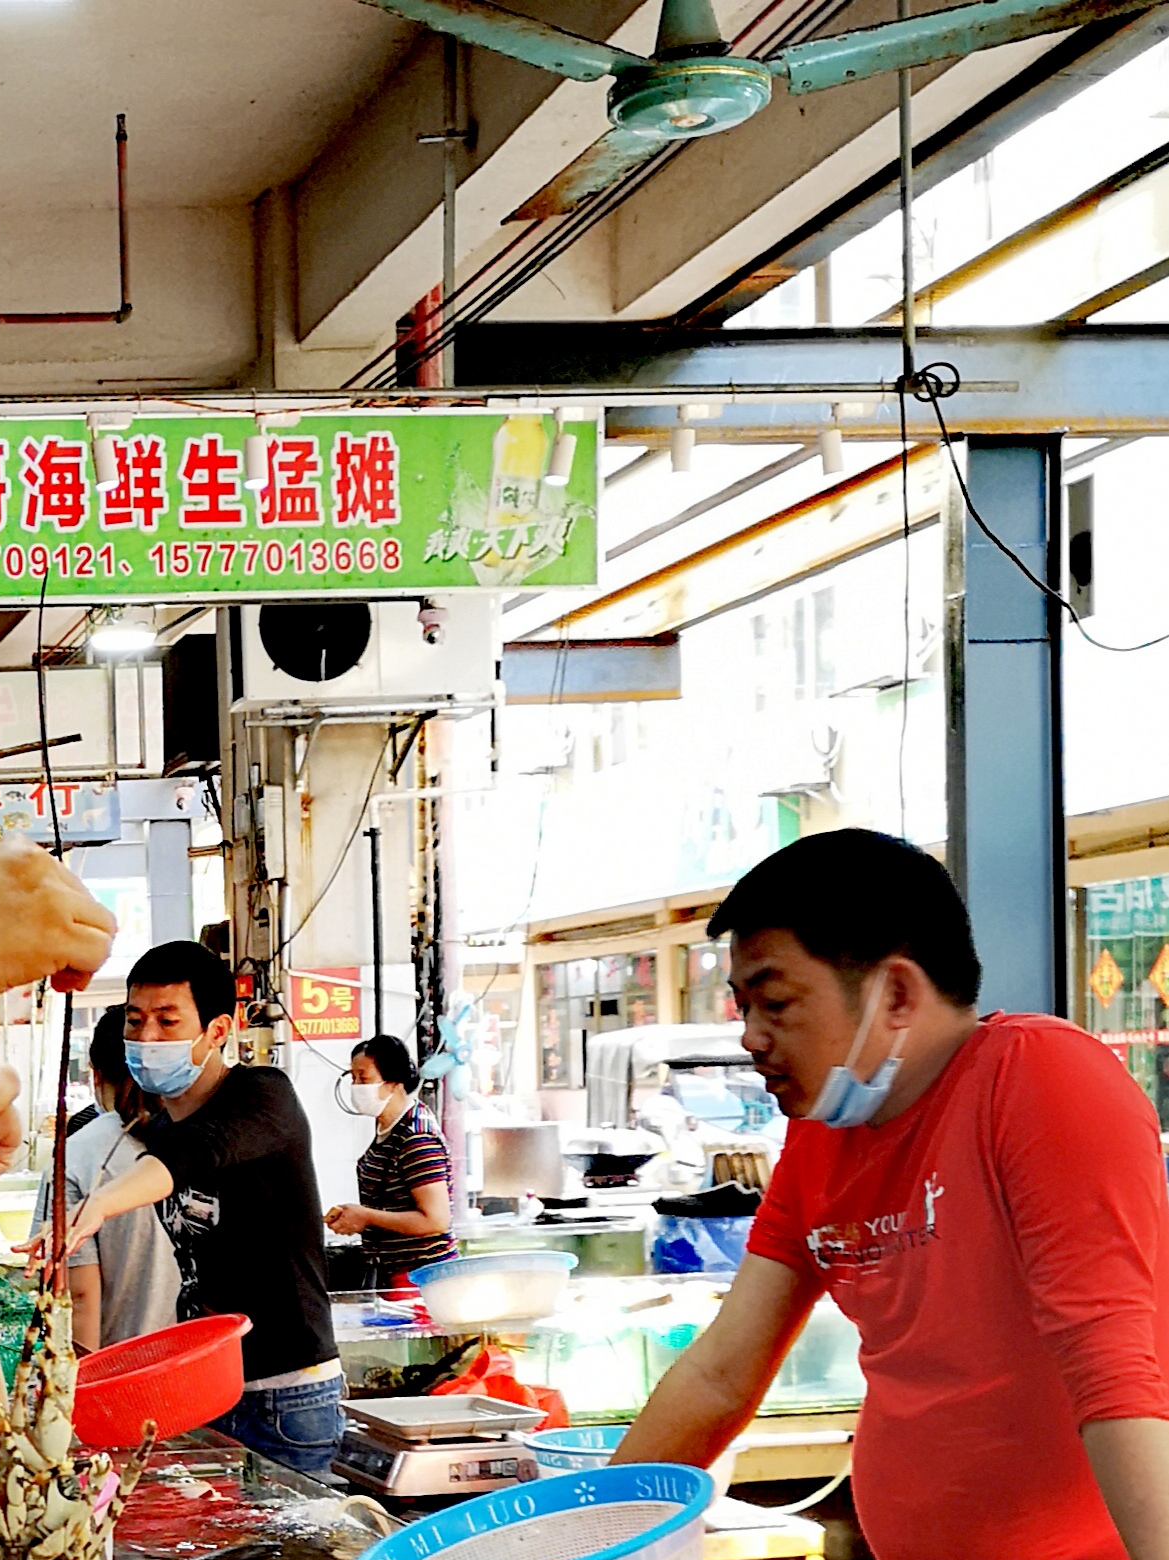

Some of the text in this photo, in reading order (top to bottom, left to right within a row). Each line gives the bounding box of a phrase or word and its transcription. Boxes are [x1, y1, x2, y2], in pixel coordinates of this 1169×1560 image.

[302, 978, 355, 1014] 5号
[409, 1526, 445, 1557] MI
[465, 1495, 536, 1534] LUO
